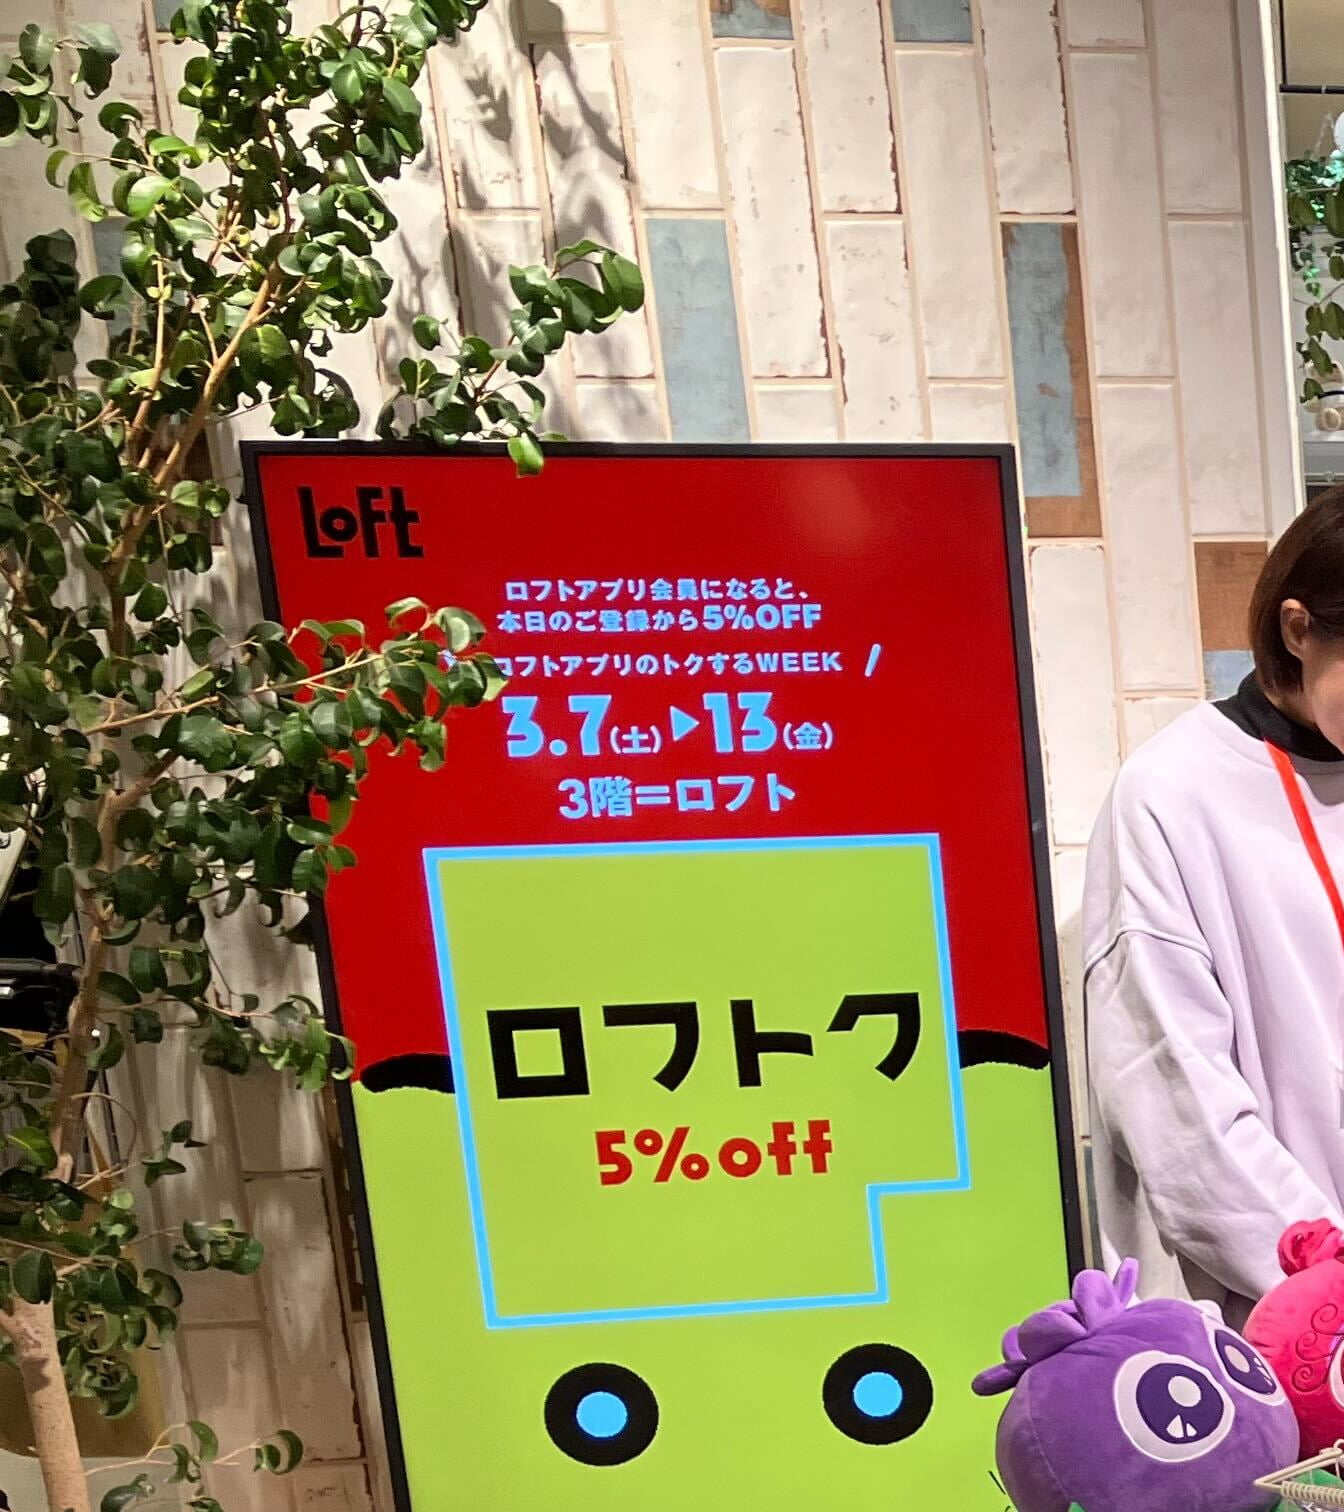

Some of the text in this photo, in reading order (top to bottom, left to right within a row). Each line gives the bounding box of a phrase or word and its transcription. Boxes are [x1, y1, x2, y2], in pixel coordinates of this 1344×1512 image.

[504, 578, 809, 602] ロフトアプリ会員になると、
[496, 603, 823, 633] 本日のご登録から5%OFF
[497, 651, 843, 678] ロフトアプリのトクするWEEK
[485, 991, 922, 1100] ロフトク
[594, 1119, 833, 1186] 5%off
